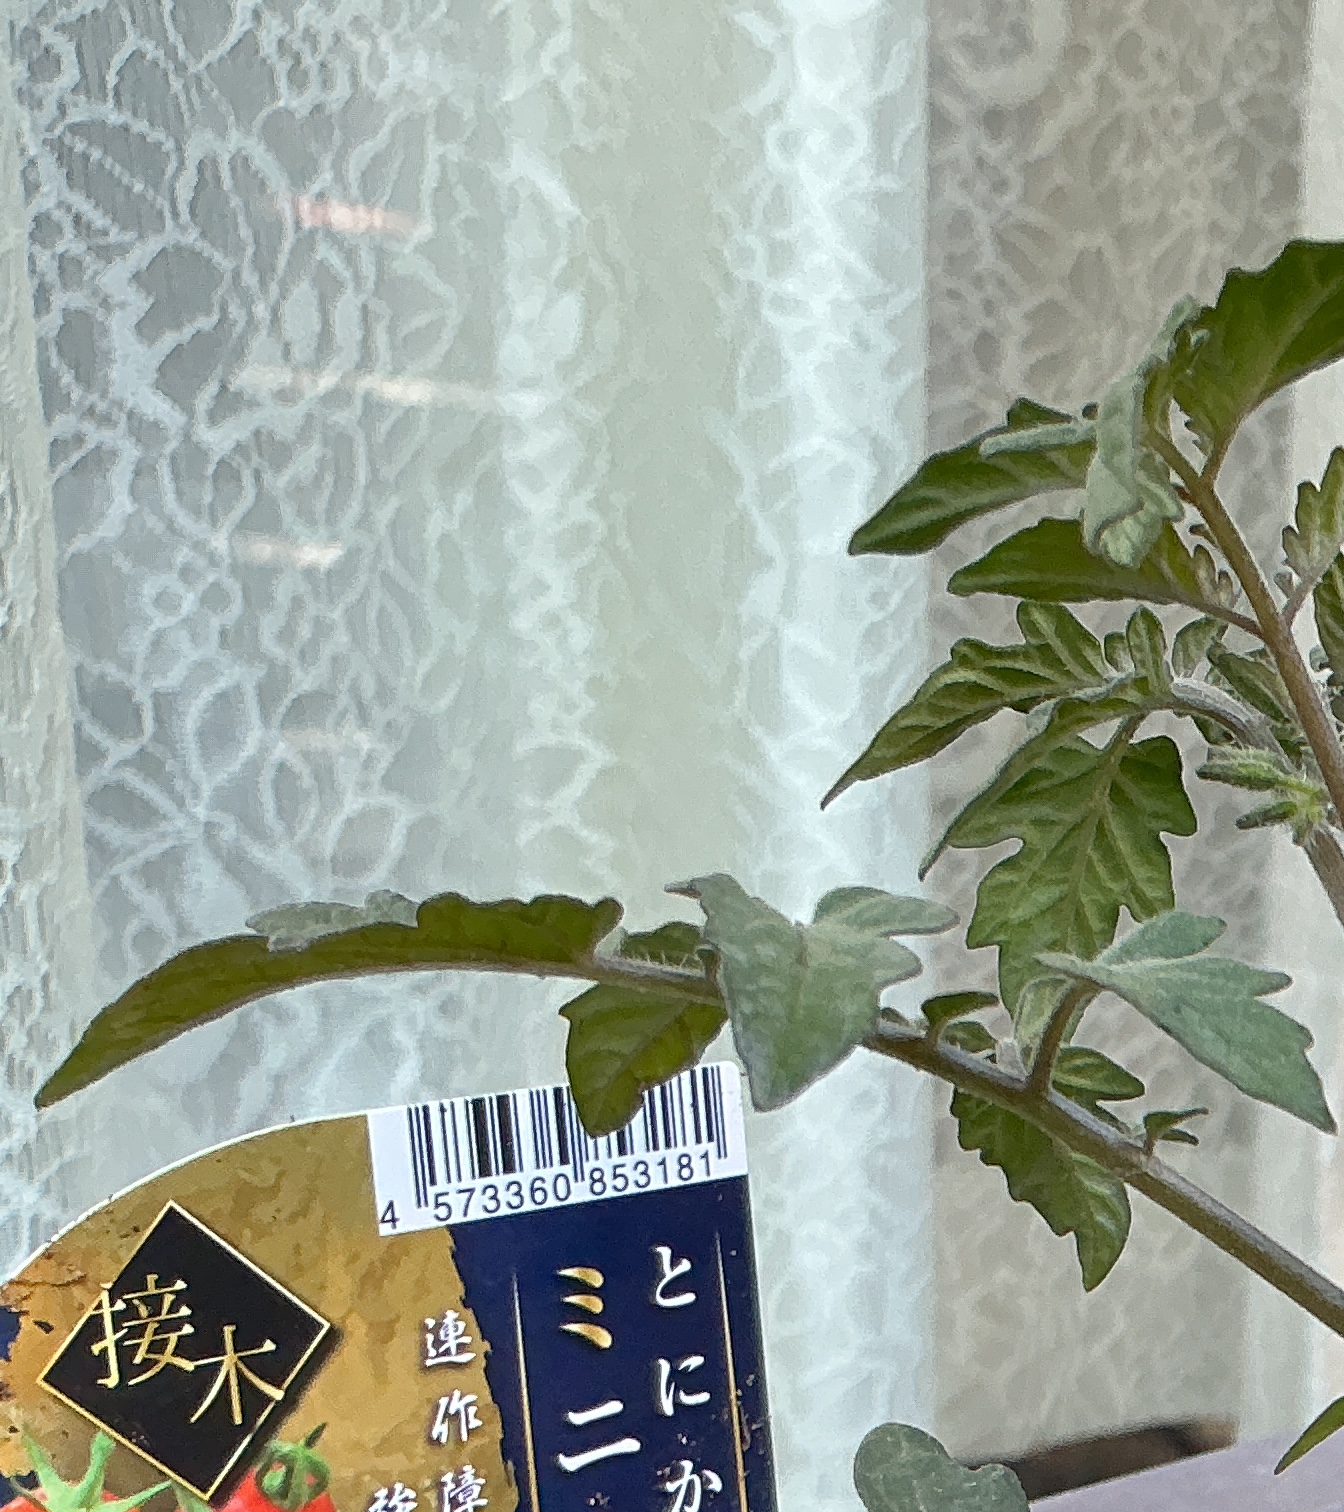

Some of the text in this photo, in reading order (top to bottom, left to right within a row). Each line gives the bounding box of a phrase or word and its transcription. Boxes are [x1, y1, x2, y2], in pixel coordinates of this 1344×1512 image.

[378, 1150, 712, 1230] 4 573360 853181
[91, 1273, 285, 1426] 接木
